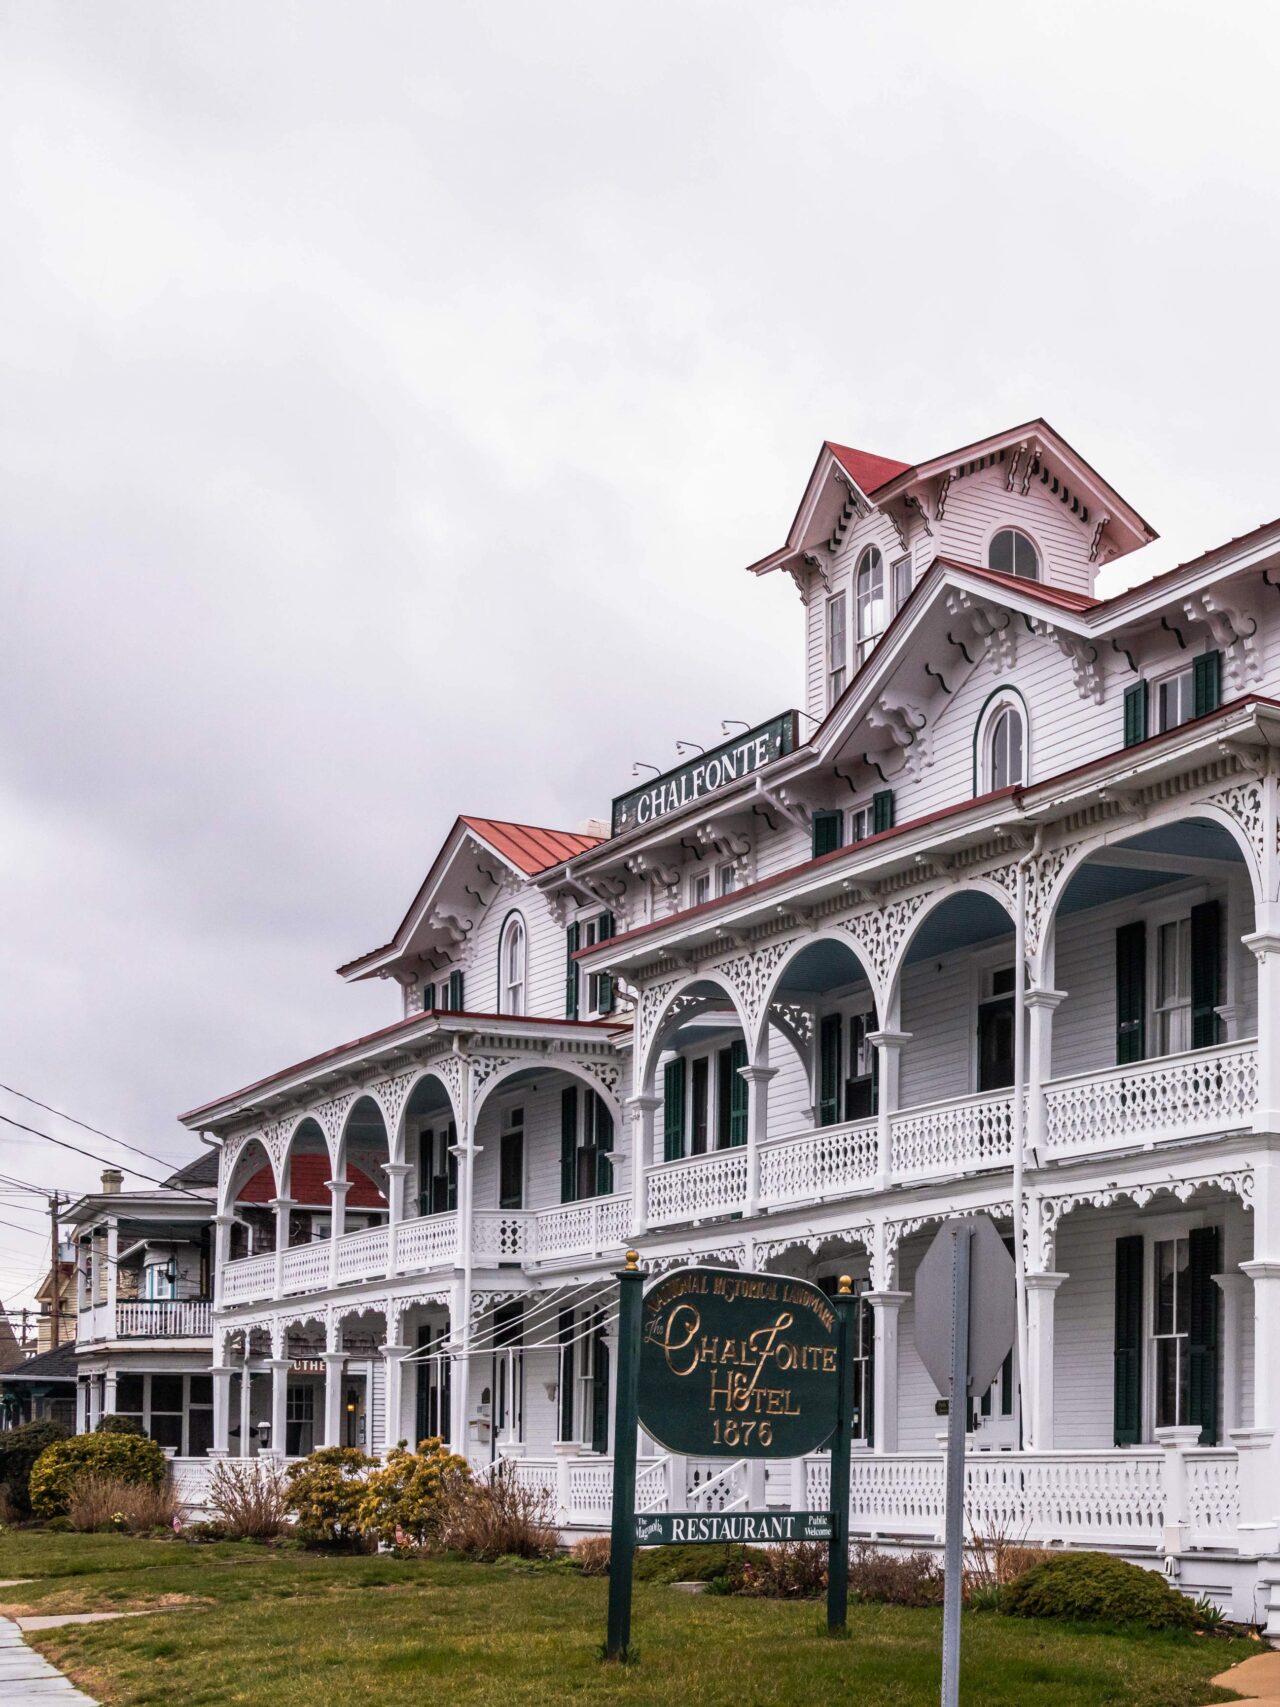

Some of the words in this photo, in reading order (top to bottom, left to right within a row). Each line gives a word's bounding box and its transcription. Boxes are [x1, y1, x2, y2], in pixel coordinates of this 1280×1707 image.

[637, 733, 770, 824] CHALFONTE
[647, 1275, 709, 1312] NATIONAL
[713, 1277, 777, 1303] HISTORICAL
[782, 1284, 836, 1334] LANDMARK
[708, 1369, 801, 1416] HOTEL
[712, 1418, 773, 1447] 1876
[671, 1516, 796, 1541] RESTAURANT
[804, 1526, 832, 1537] Welcome
[808, 1514, 828, 1526] Public
